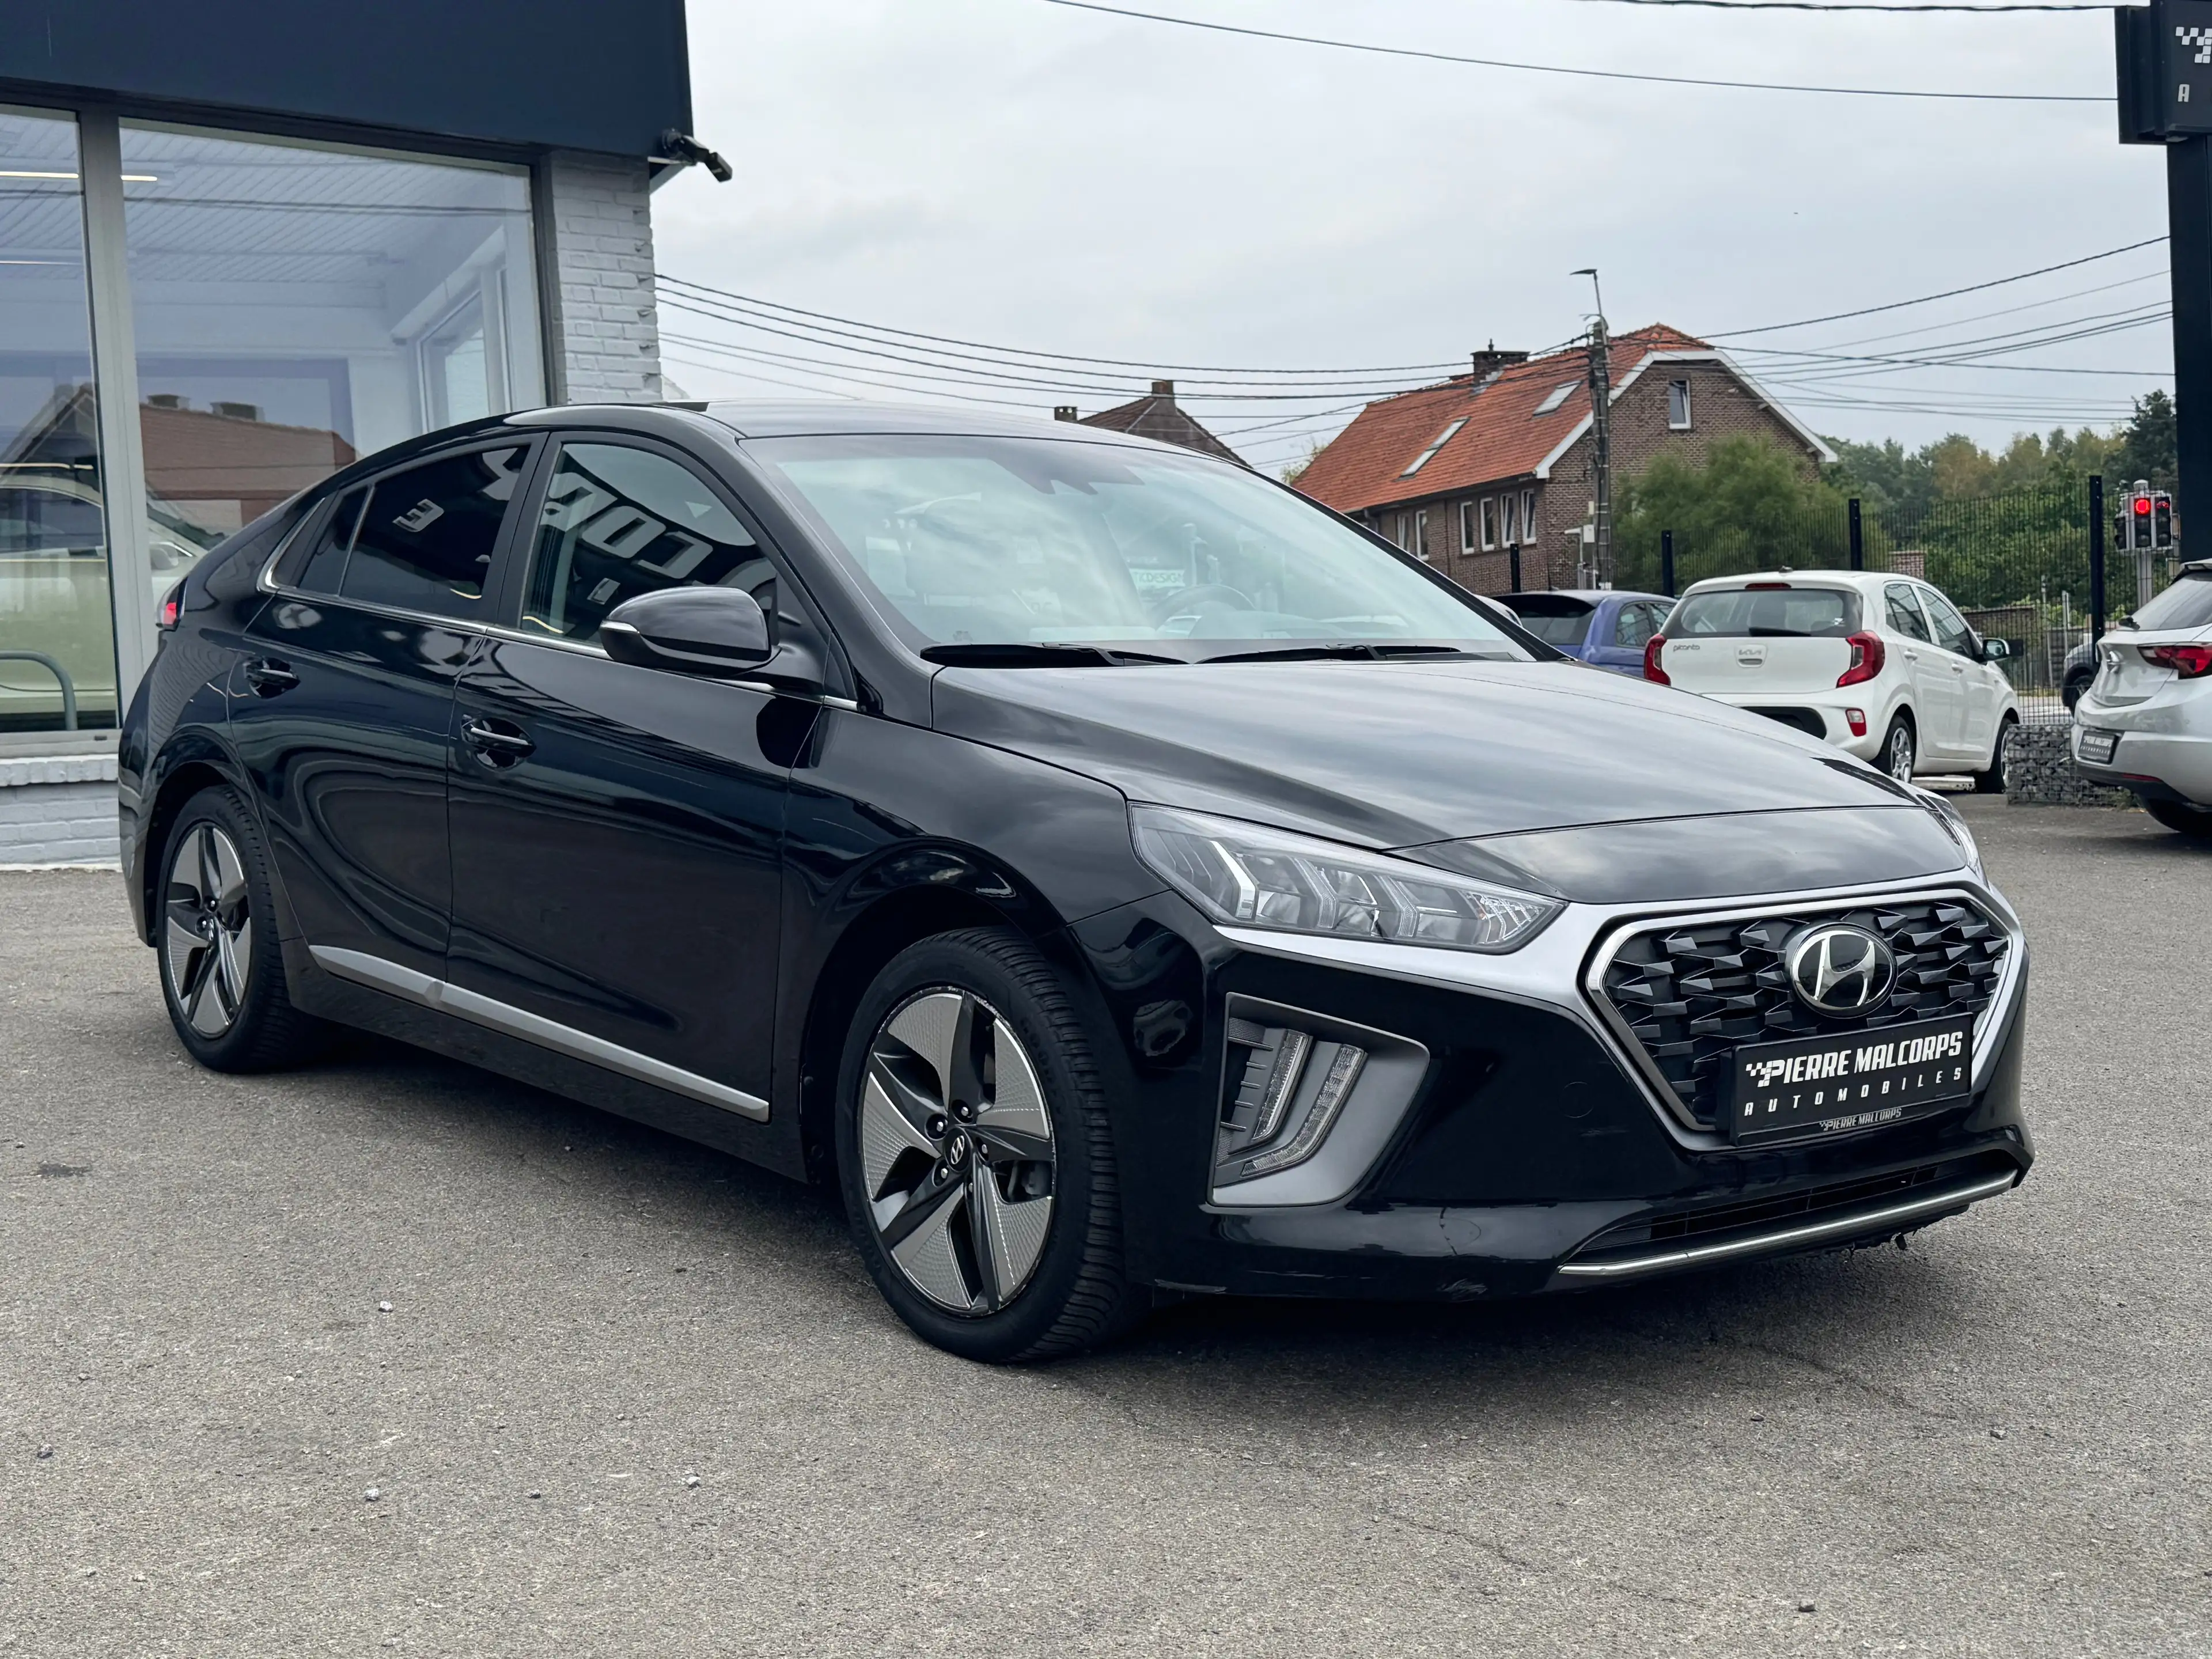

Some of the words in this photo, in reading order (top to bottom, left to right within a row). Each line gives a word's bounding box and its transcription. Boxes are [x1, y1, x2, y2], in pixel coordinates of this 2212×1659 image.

[1745, 1050, 1851, 1088] PIERRE
[1854, 1031, 1963, 1073] MALCORPS
[1744, 1067, 1962, 1116] AUTOMOBILES
[1819, 1116, 1857, 1131] PIERRE
